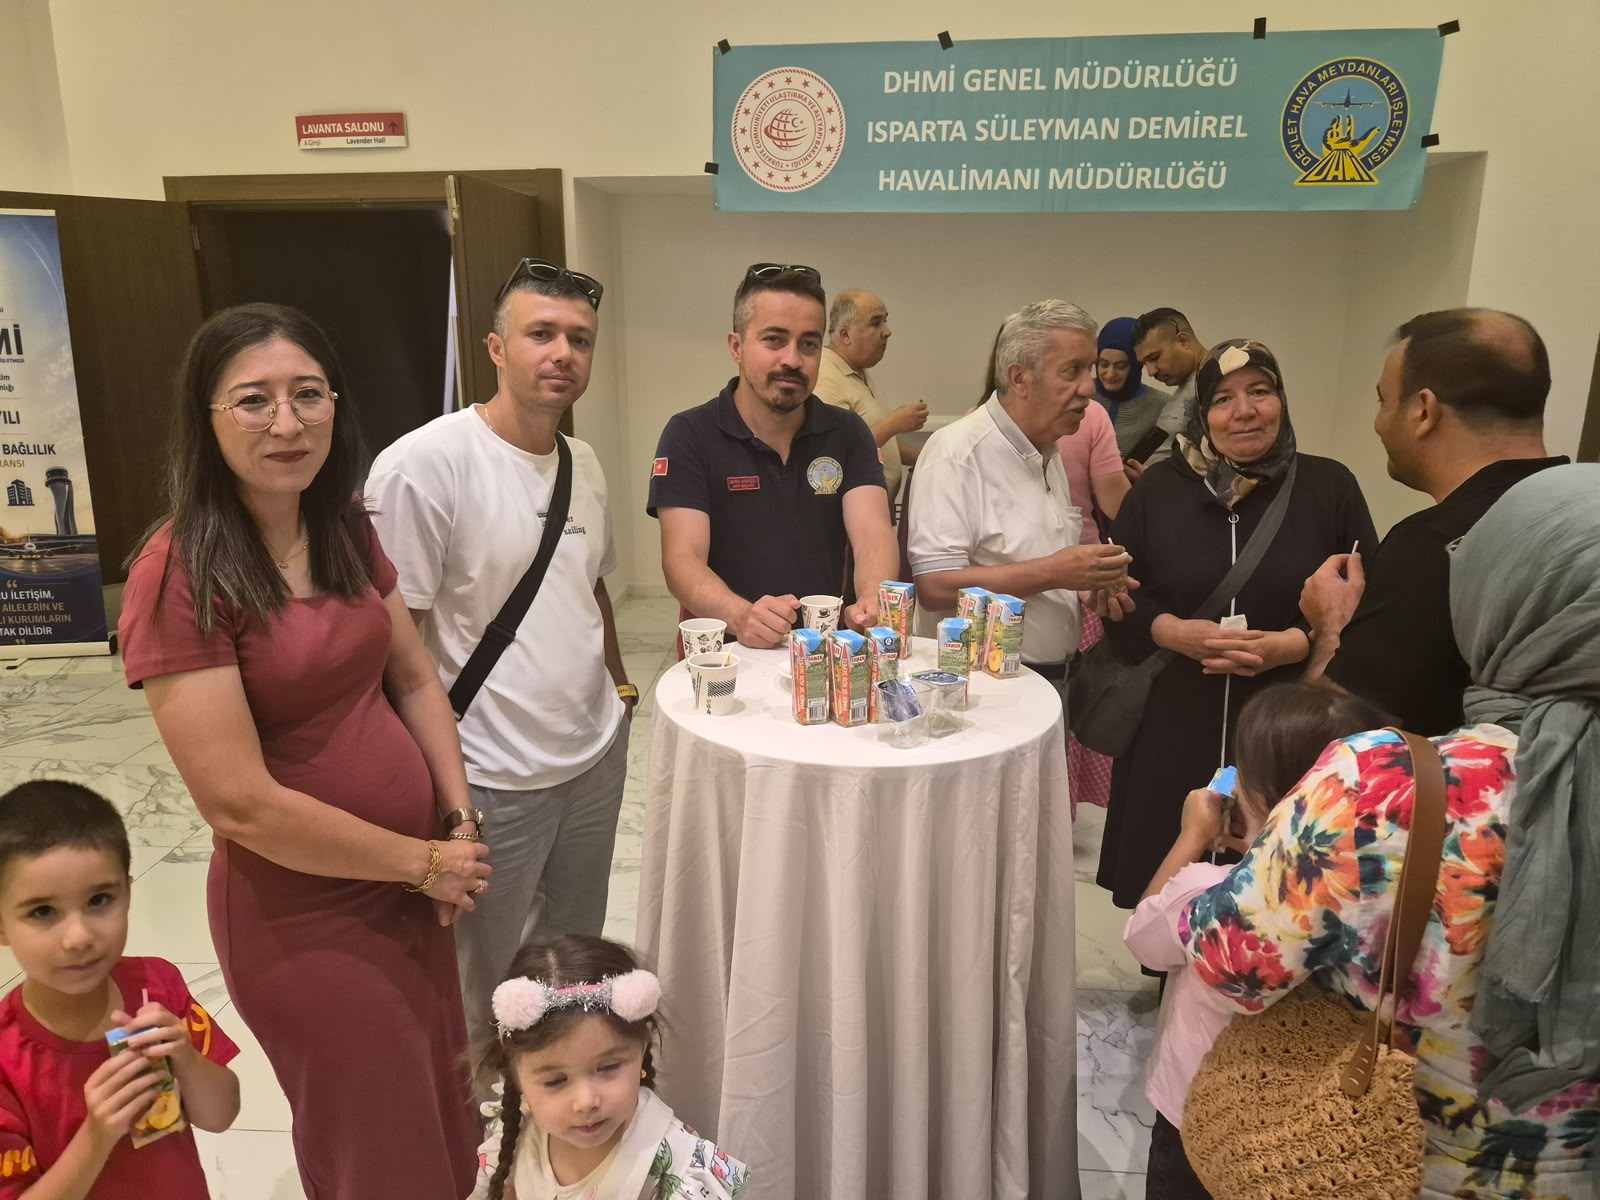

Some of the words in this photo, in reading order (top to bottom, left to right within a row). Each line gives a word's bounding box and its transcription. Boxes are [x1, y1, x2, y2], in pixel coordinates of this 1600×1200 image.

[884, 64, 955, 94] DHMİ
[963, 67, 1047, 92] GENEL
[1054, 57, 1238, 91] MÜDÜRLÜĞÜ
[1316, 61, 1400, 97] MEYDANLARI
[769, 91, 808, 103] ULAŞTIRMA
[807, 100, 816, 111] VE
[1290, 81, 1317, 114] HAVA
[302, 122, 344, 135] LAVANTA
[344, 121, 385, 133] SALONU
[752, 100, 770, 149] CUMHURİYETİ
[813, 109, 824, 137] ALTYAPI
[867, 119, 968, 143] ISPARTA
[974, 113, 1120, 143] SÜLEYMAN
[1128, 110, 1248, 139] DEMİREL
[1367, 96, 1405, 168] İŞLETMESİ
[346, 137, 374, 145] Lavender
[1287, 118, 1312, 167] DEVLET
[760, 149, 784, 168] TÜRKİYE
[791, 137, 821, 168] BAKANLIĞI
[878, 163, 1040, 192] HAVALİMANI
[1048, 160, 1227, 190] MÜDÜRLÜĞÜ
[2, 441, 56, 455] BAĞLILIK
[563, 526, 587, 535] sailing
[11, 589, 55, 601] İLETİŞİM,
[2, 602, 50, 612] AİLELERİN
[52, 602, 65, 611] VE
[8, 614, 72, 624] KURUMLARIN
[19, 624, 53, 636] DİLİDİR
